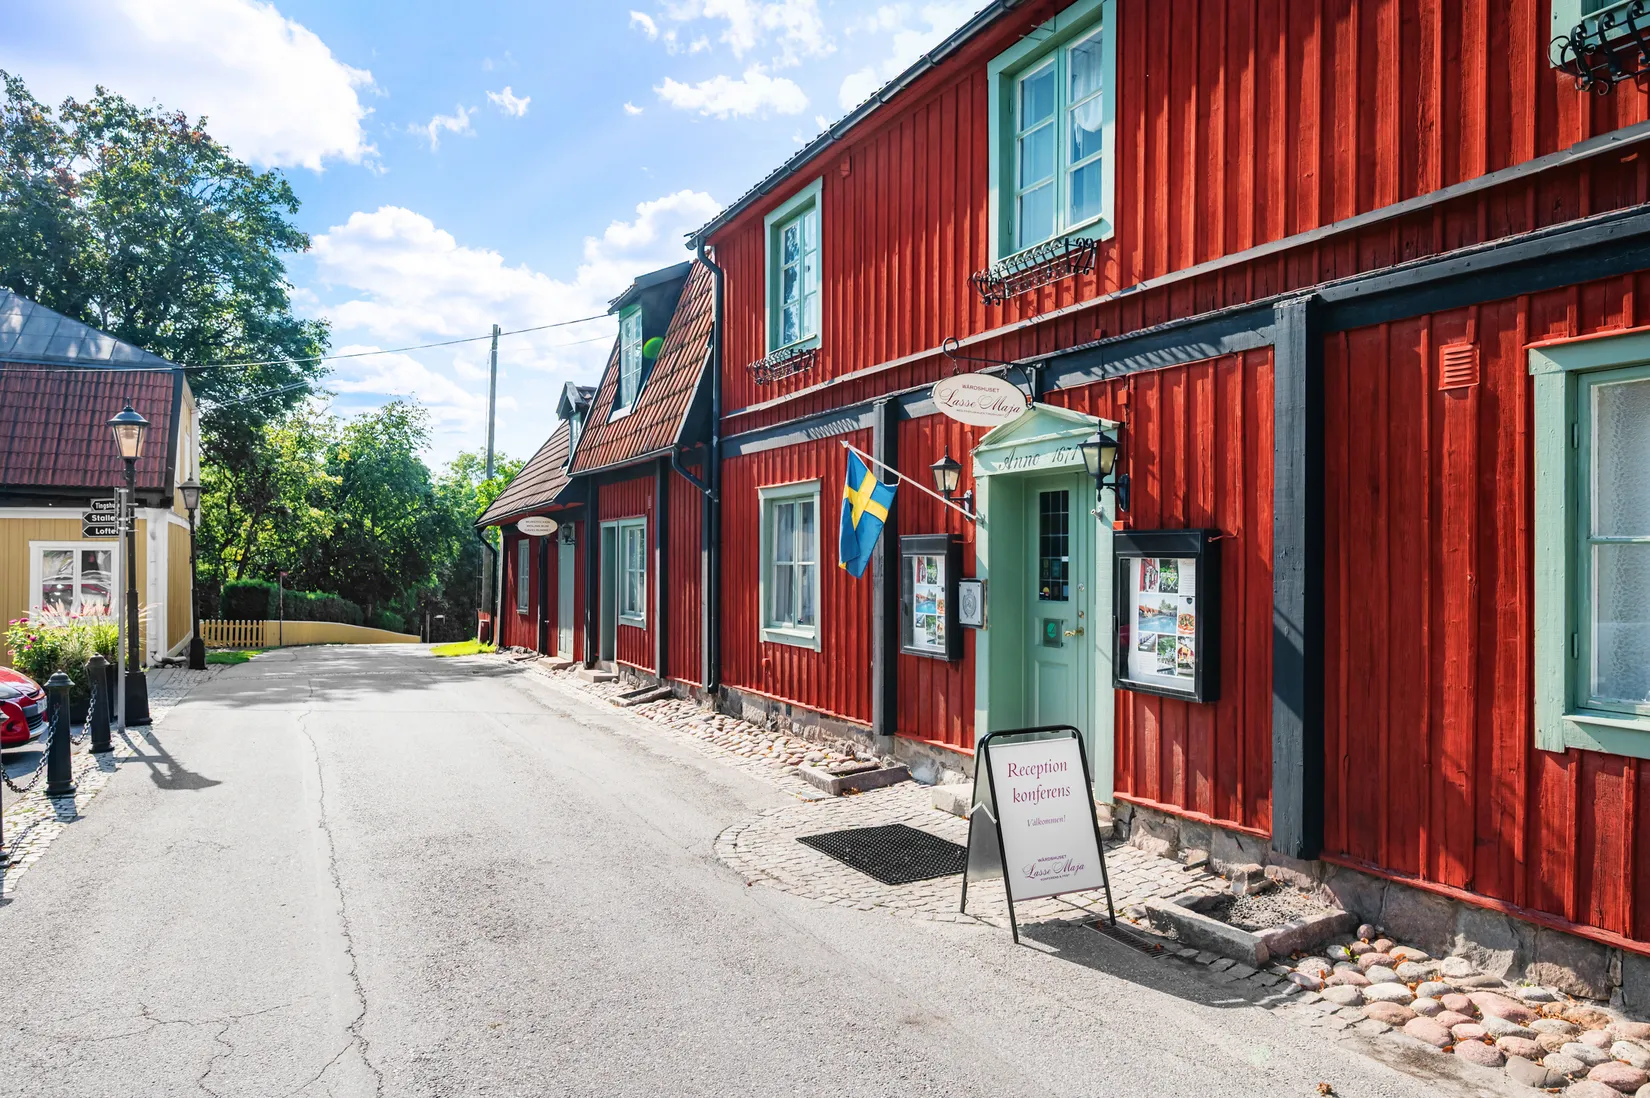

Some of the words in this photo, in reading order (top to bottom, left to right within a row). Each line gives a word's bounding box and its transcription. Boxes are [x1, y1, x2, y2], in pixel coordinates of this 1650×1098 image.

[939, 388, 979, 408] Lasse
[978, 395, 1021, 418] Maja
[998, 446, 1041, 471] Anno
[91, 514, 117, 522] Stalle
[1008, 758, 1067, 779] Reception
[1013, 784, 1071, 805] konferens
[1022, 863, 1051, 879] Lasse
[1052, 858, 1085, 876] Maja
